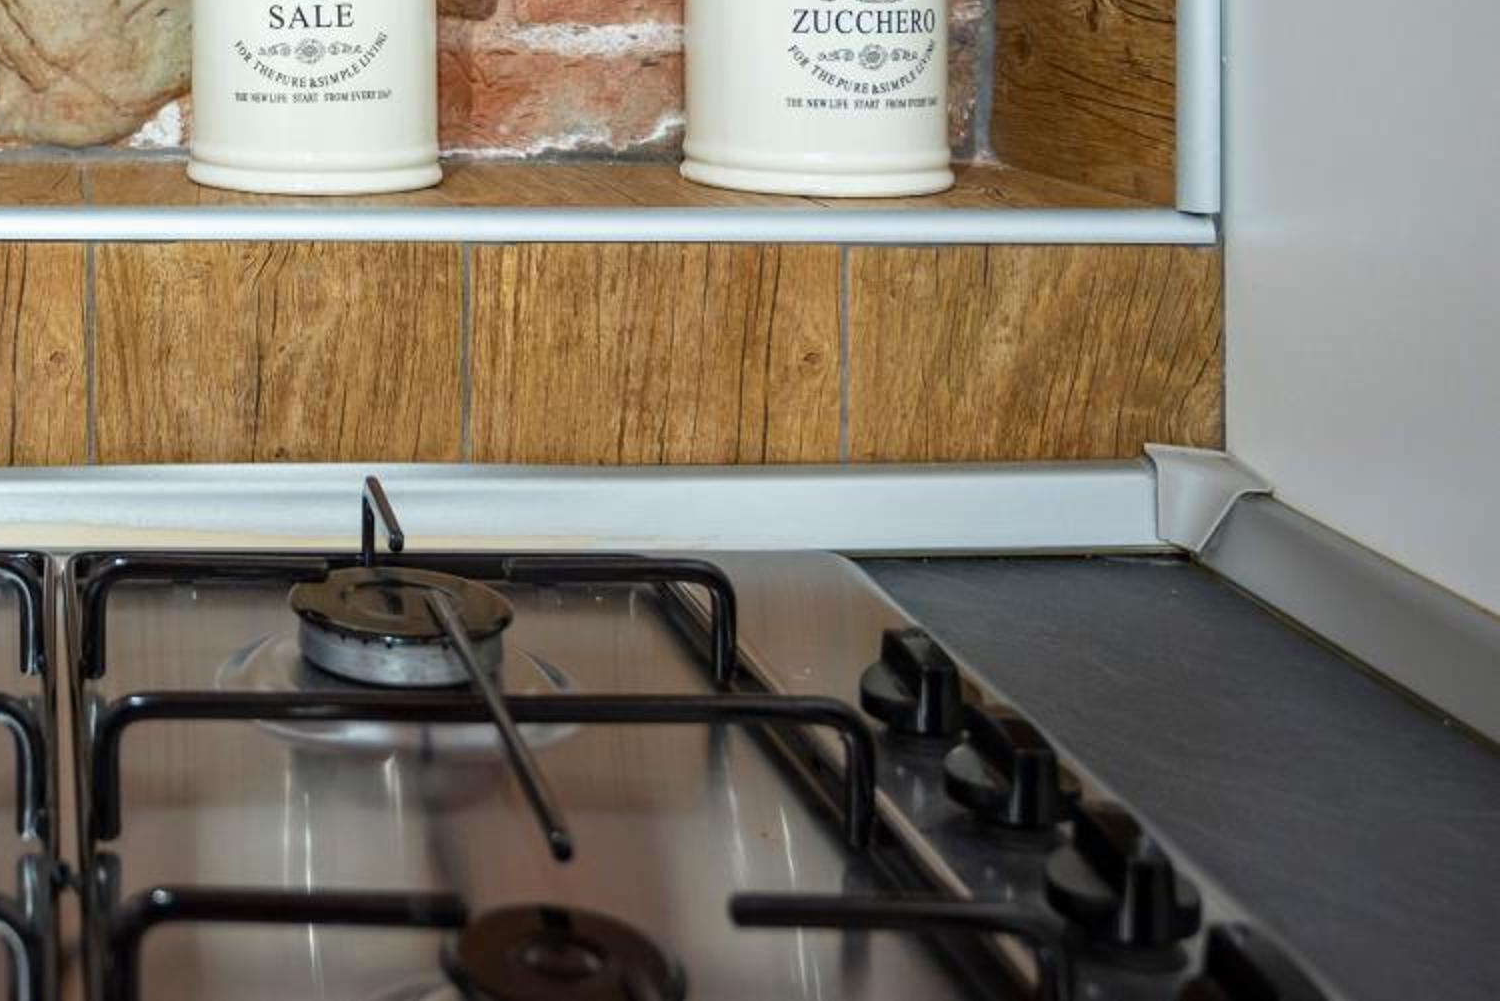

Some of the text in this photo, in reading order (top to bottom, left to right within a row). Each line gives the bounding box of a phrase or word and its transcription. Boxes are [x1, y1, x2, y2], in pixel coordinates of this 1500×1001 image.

[268, 3, 355, 30] SALE
[792, 8, 936, 34] ZUCCHERO
[234, 39, 253, 63] FOR
[253, 59, 275, 80] THE
[275, 72, 307, 88] PURE
[788, 43, 810, 68] FOR
[810, 64, 836, 85] THE
[835, 78, 869, 94] PURE
